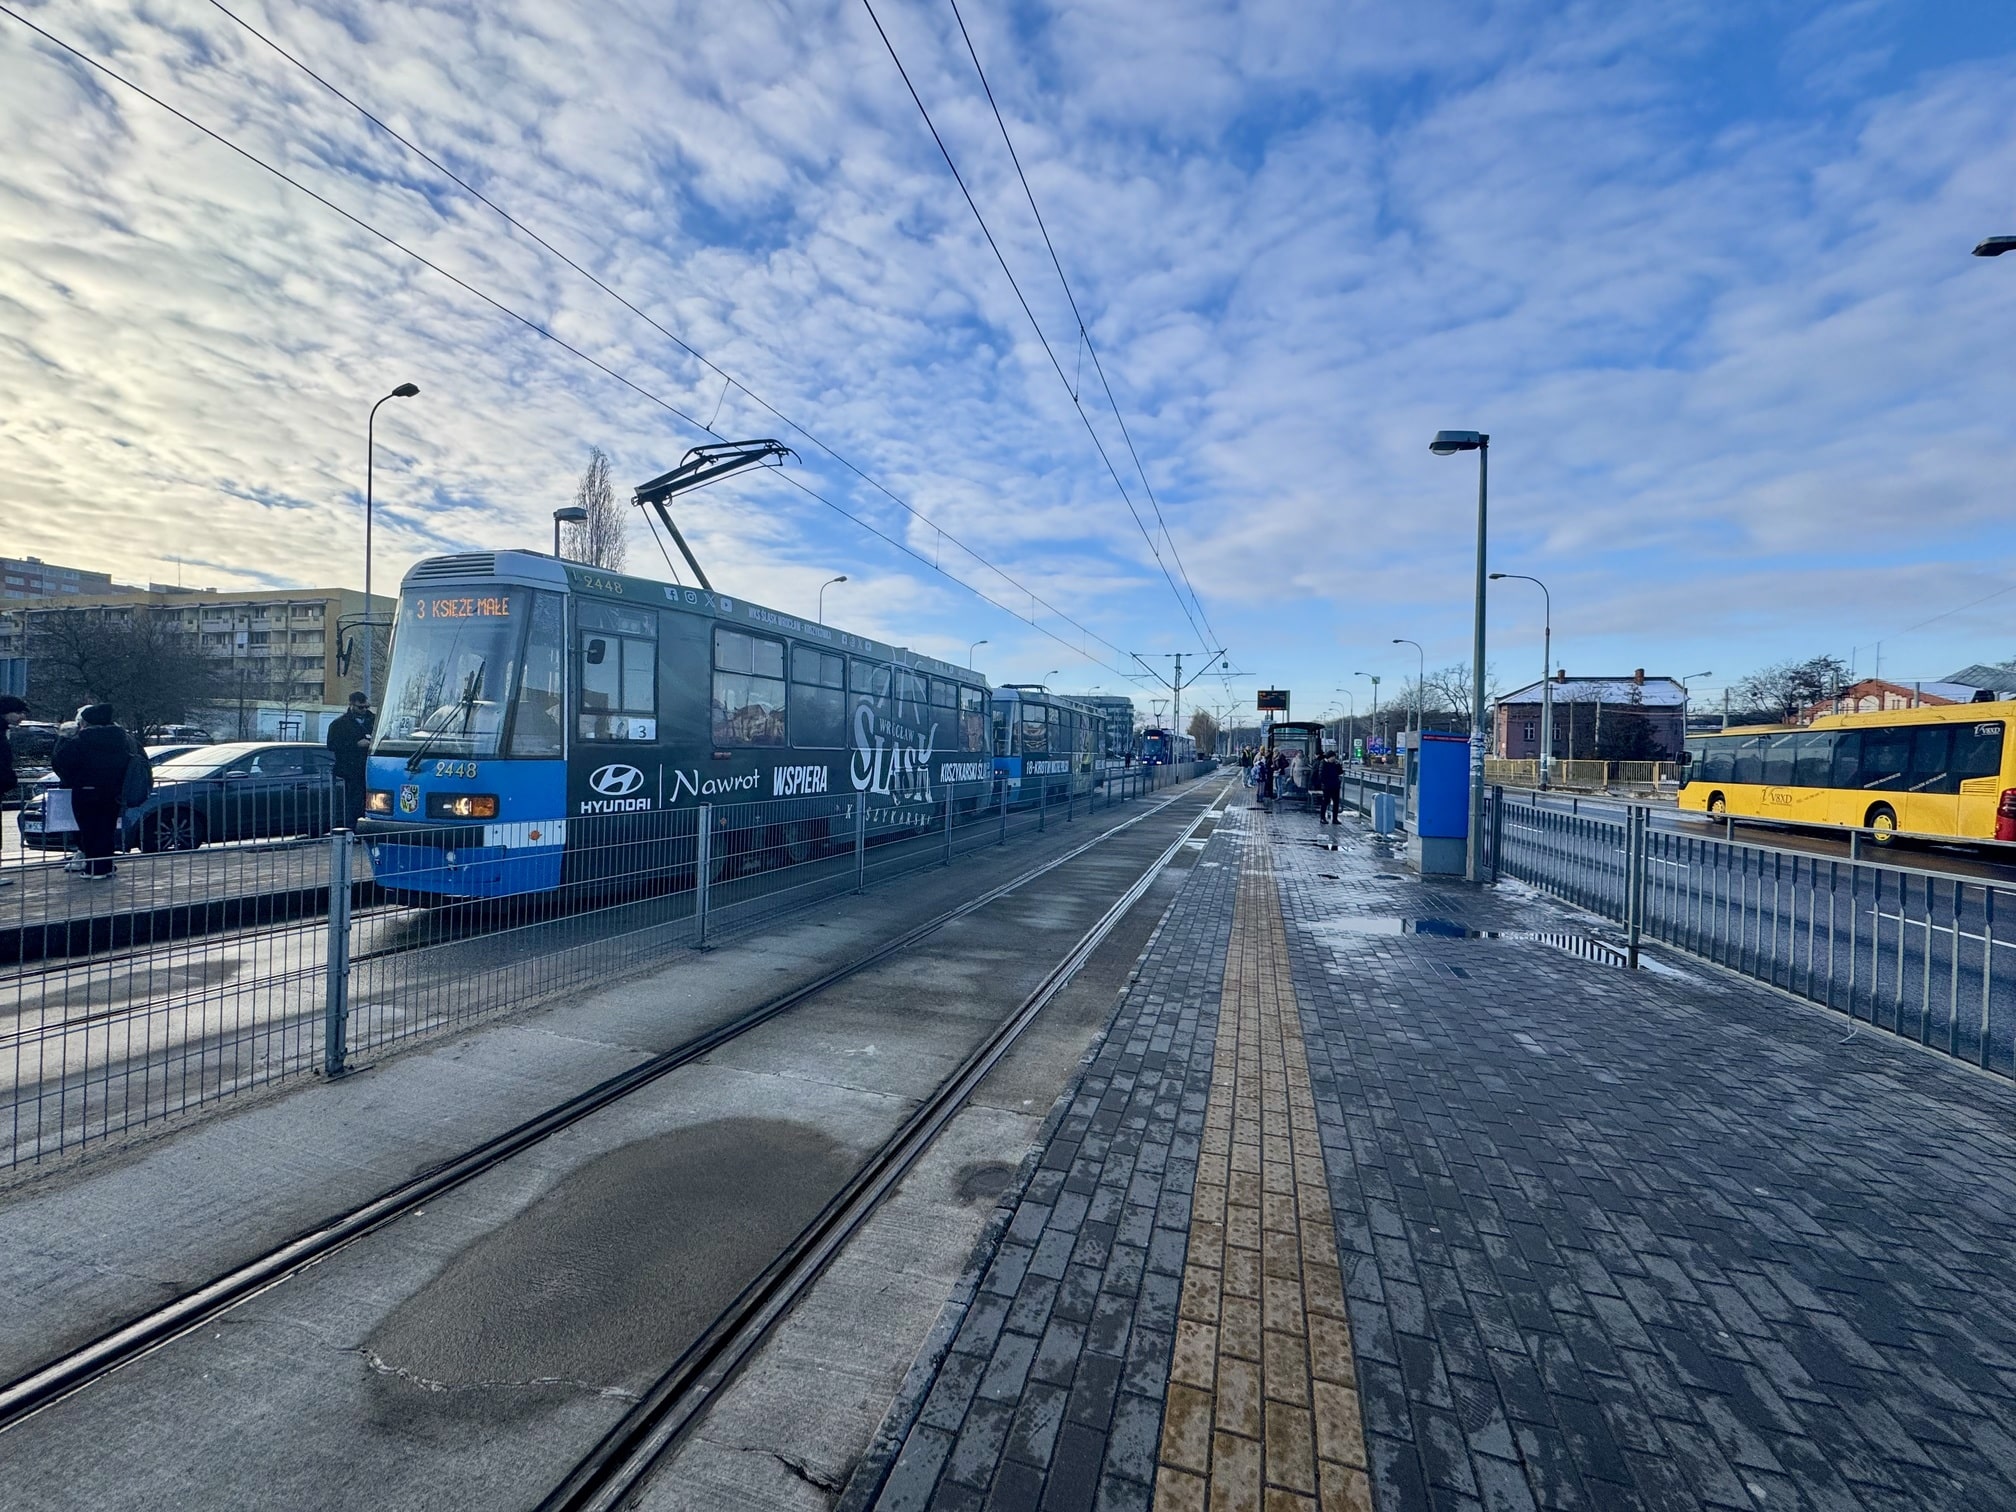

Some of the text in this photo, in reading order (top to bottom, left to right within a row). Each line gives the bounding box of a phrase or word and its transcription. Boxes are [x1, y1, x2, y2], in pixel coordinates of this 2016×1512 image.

[584, 575, 624, 594] 2448
[417, 599, 426, 619] 3
[477, 596, 510, 616] MAŁE
[638, 725, 647, 738] 3
[435, 761, 478, 778] 2448
[670, 765, 828, 803] Nawrot WSPIERA
[581, 798, 651, 814] HYUNDAI
[845, 803, 932, 826] KSZYKARSKI
